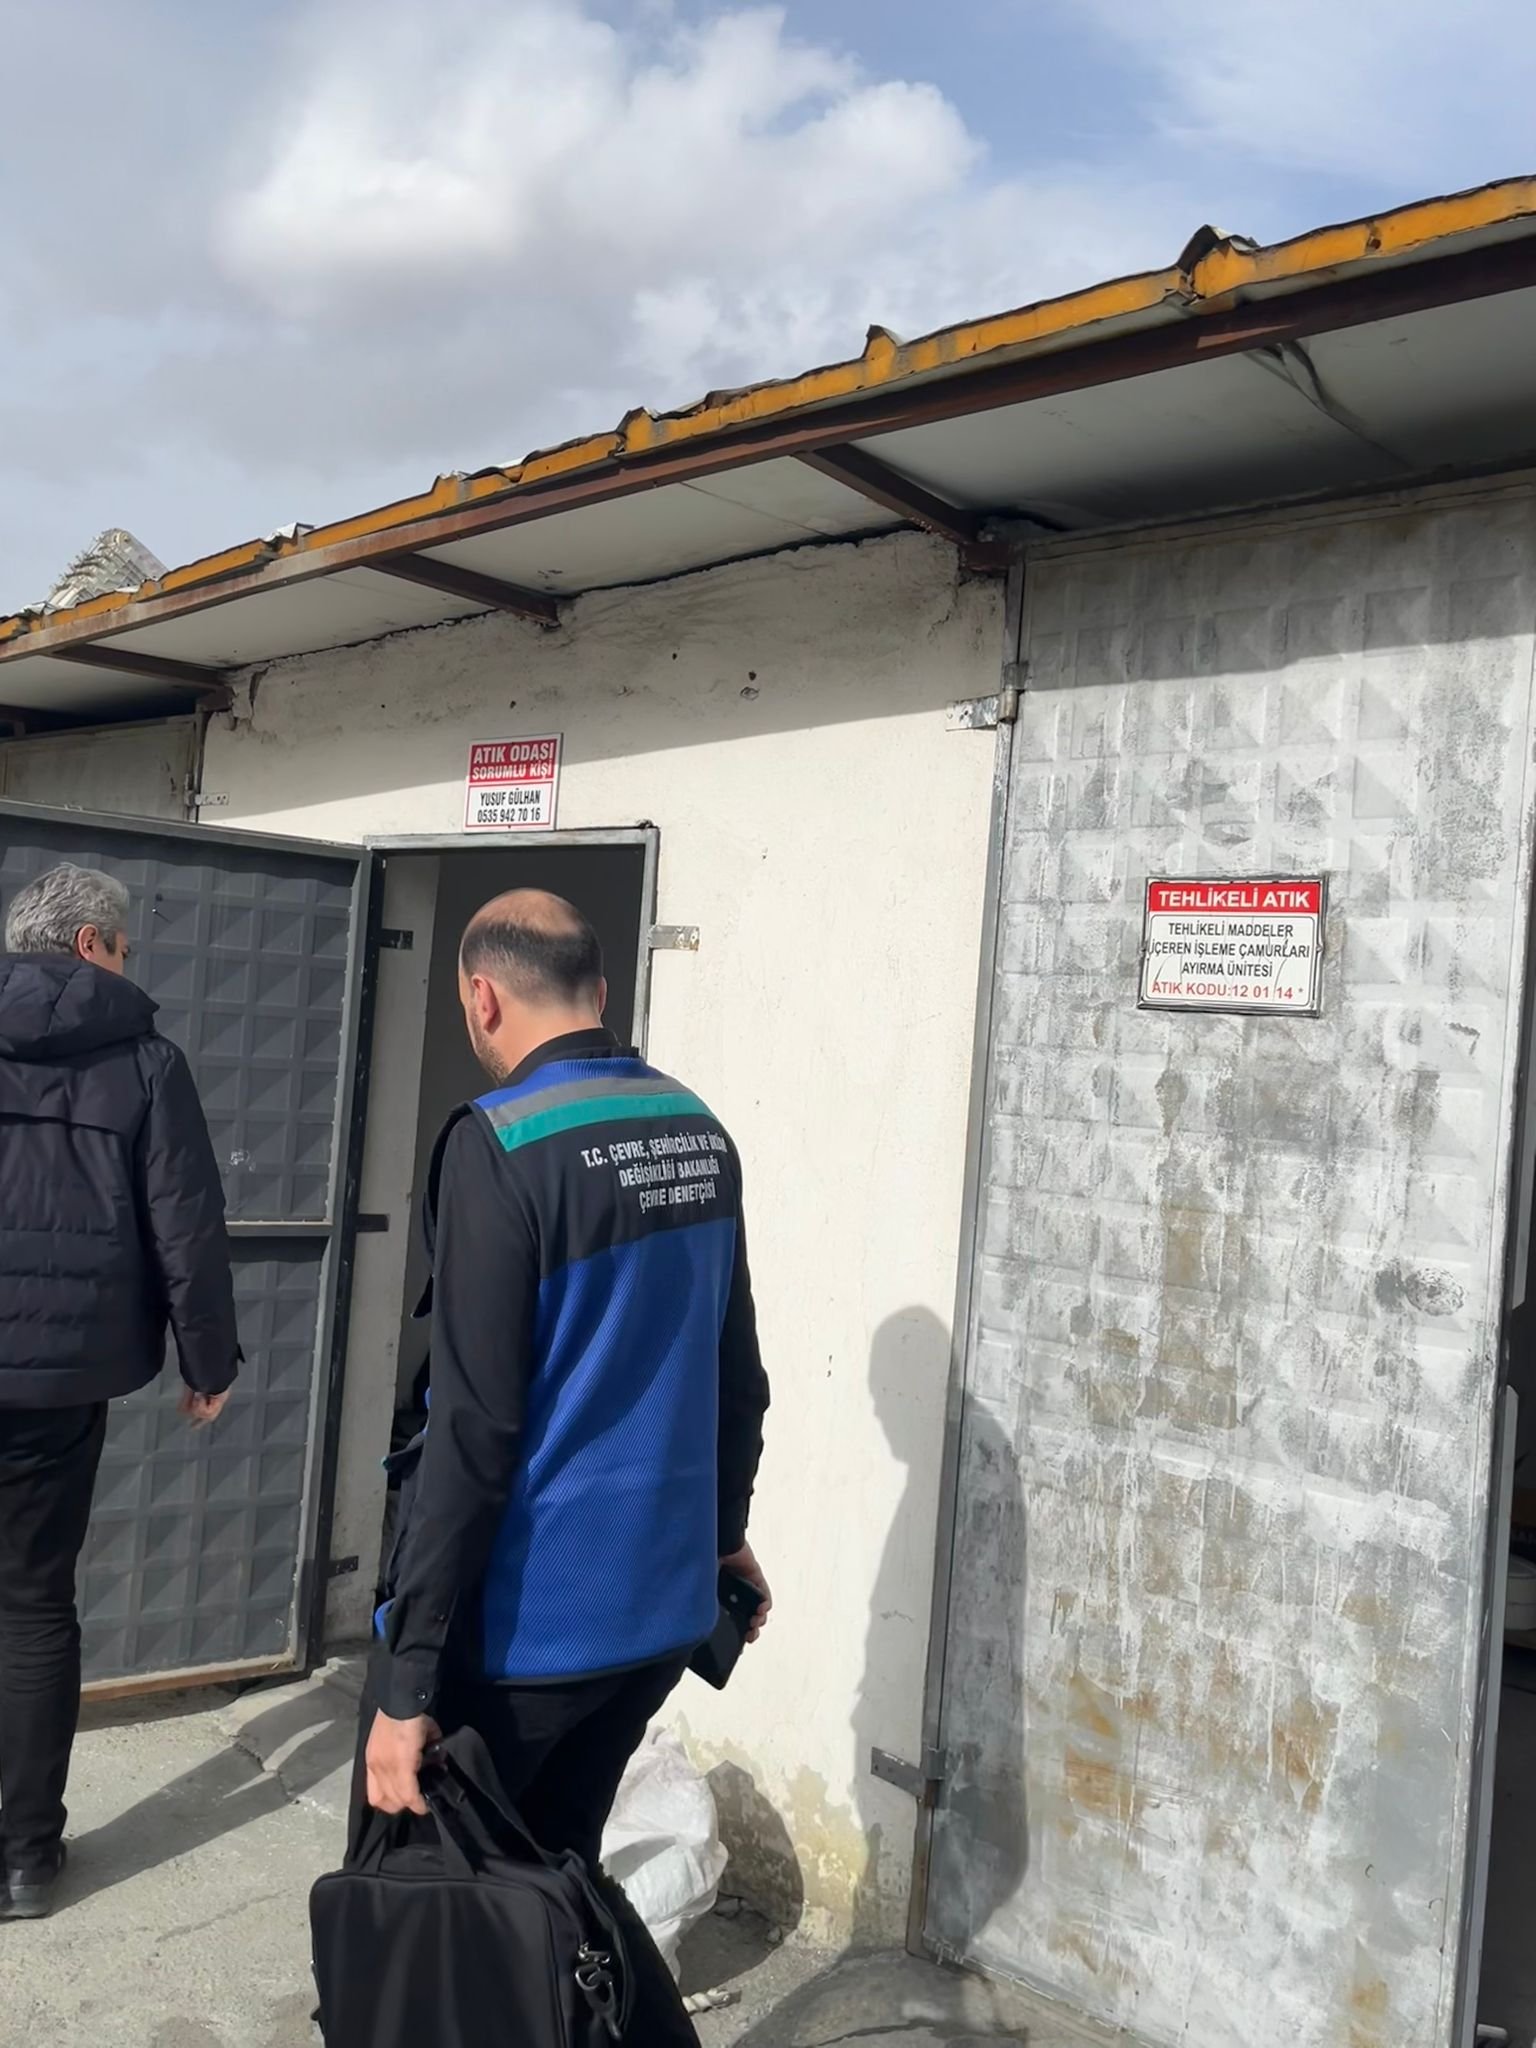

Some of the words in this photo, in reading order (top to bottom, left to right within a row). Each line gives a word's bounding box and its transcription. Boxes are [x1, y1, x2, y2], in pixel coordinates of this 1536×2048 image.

[473, 746, 506, 764] ATIK
[509, 742, 554, 762] ODASI
[472, 763, 526, 780] SORUMLU
[529, 759, 552, 779] KİŞİ
[480, 791, 507, 806] YUSUF
[508, 787, 541, 805] GÜLHAN
[477, 808, 498, 823] 0535
[500, 808, 515, 823] 942
[518, 807, 528, 822] 70
[531, 807, 541, 821] 16
[1158, 887, 1259, 908] TEHLİKELİ
[1262, 890, 1310, 909] ATIK
[1168, 919, 1225, 936] TEHLİKELİ
[1228, 923, 1294, 938] MADDELER
[1151, 938, 1192, 956] İÇEREN
[1194, 939, 1236, 959] İŞLEME
[1239, 942, 1310, 960] ÇAMURLARI
[1181, 961, 1225, 976] AYIRMA
[1227, 959, 1273, 978] ÜNİTESİ
[1151, 981, 1183, 995] ATIK
[1253, 985, 1269, 999] 01
[1276, 986, 1293, 1000] 14
[580, 1147, 608, 1168] T.C.
